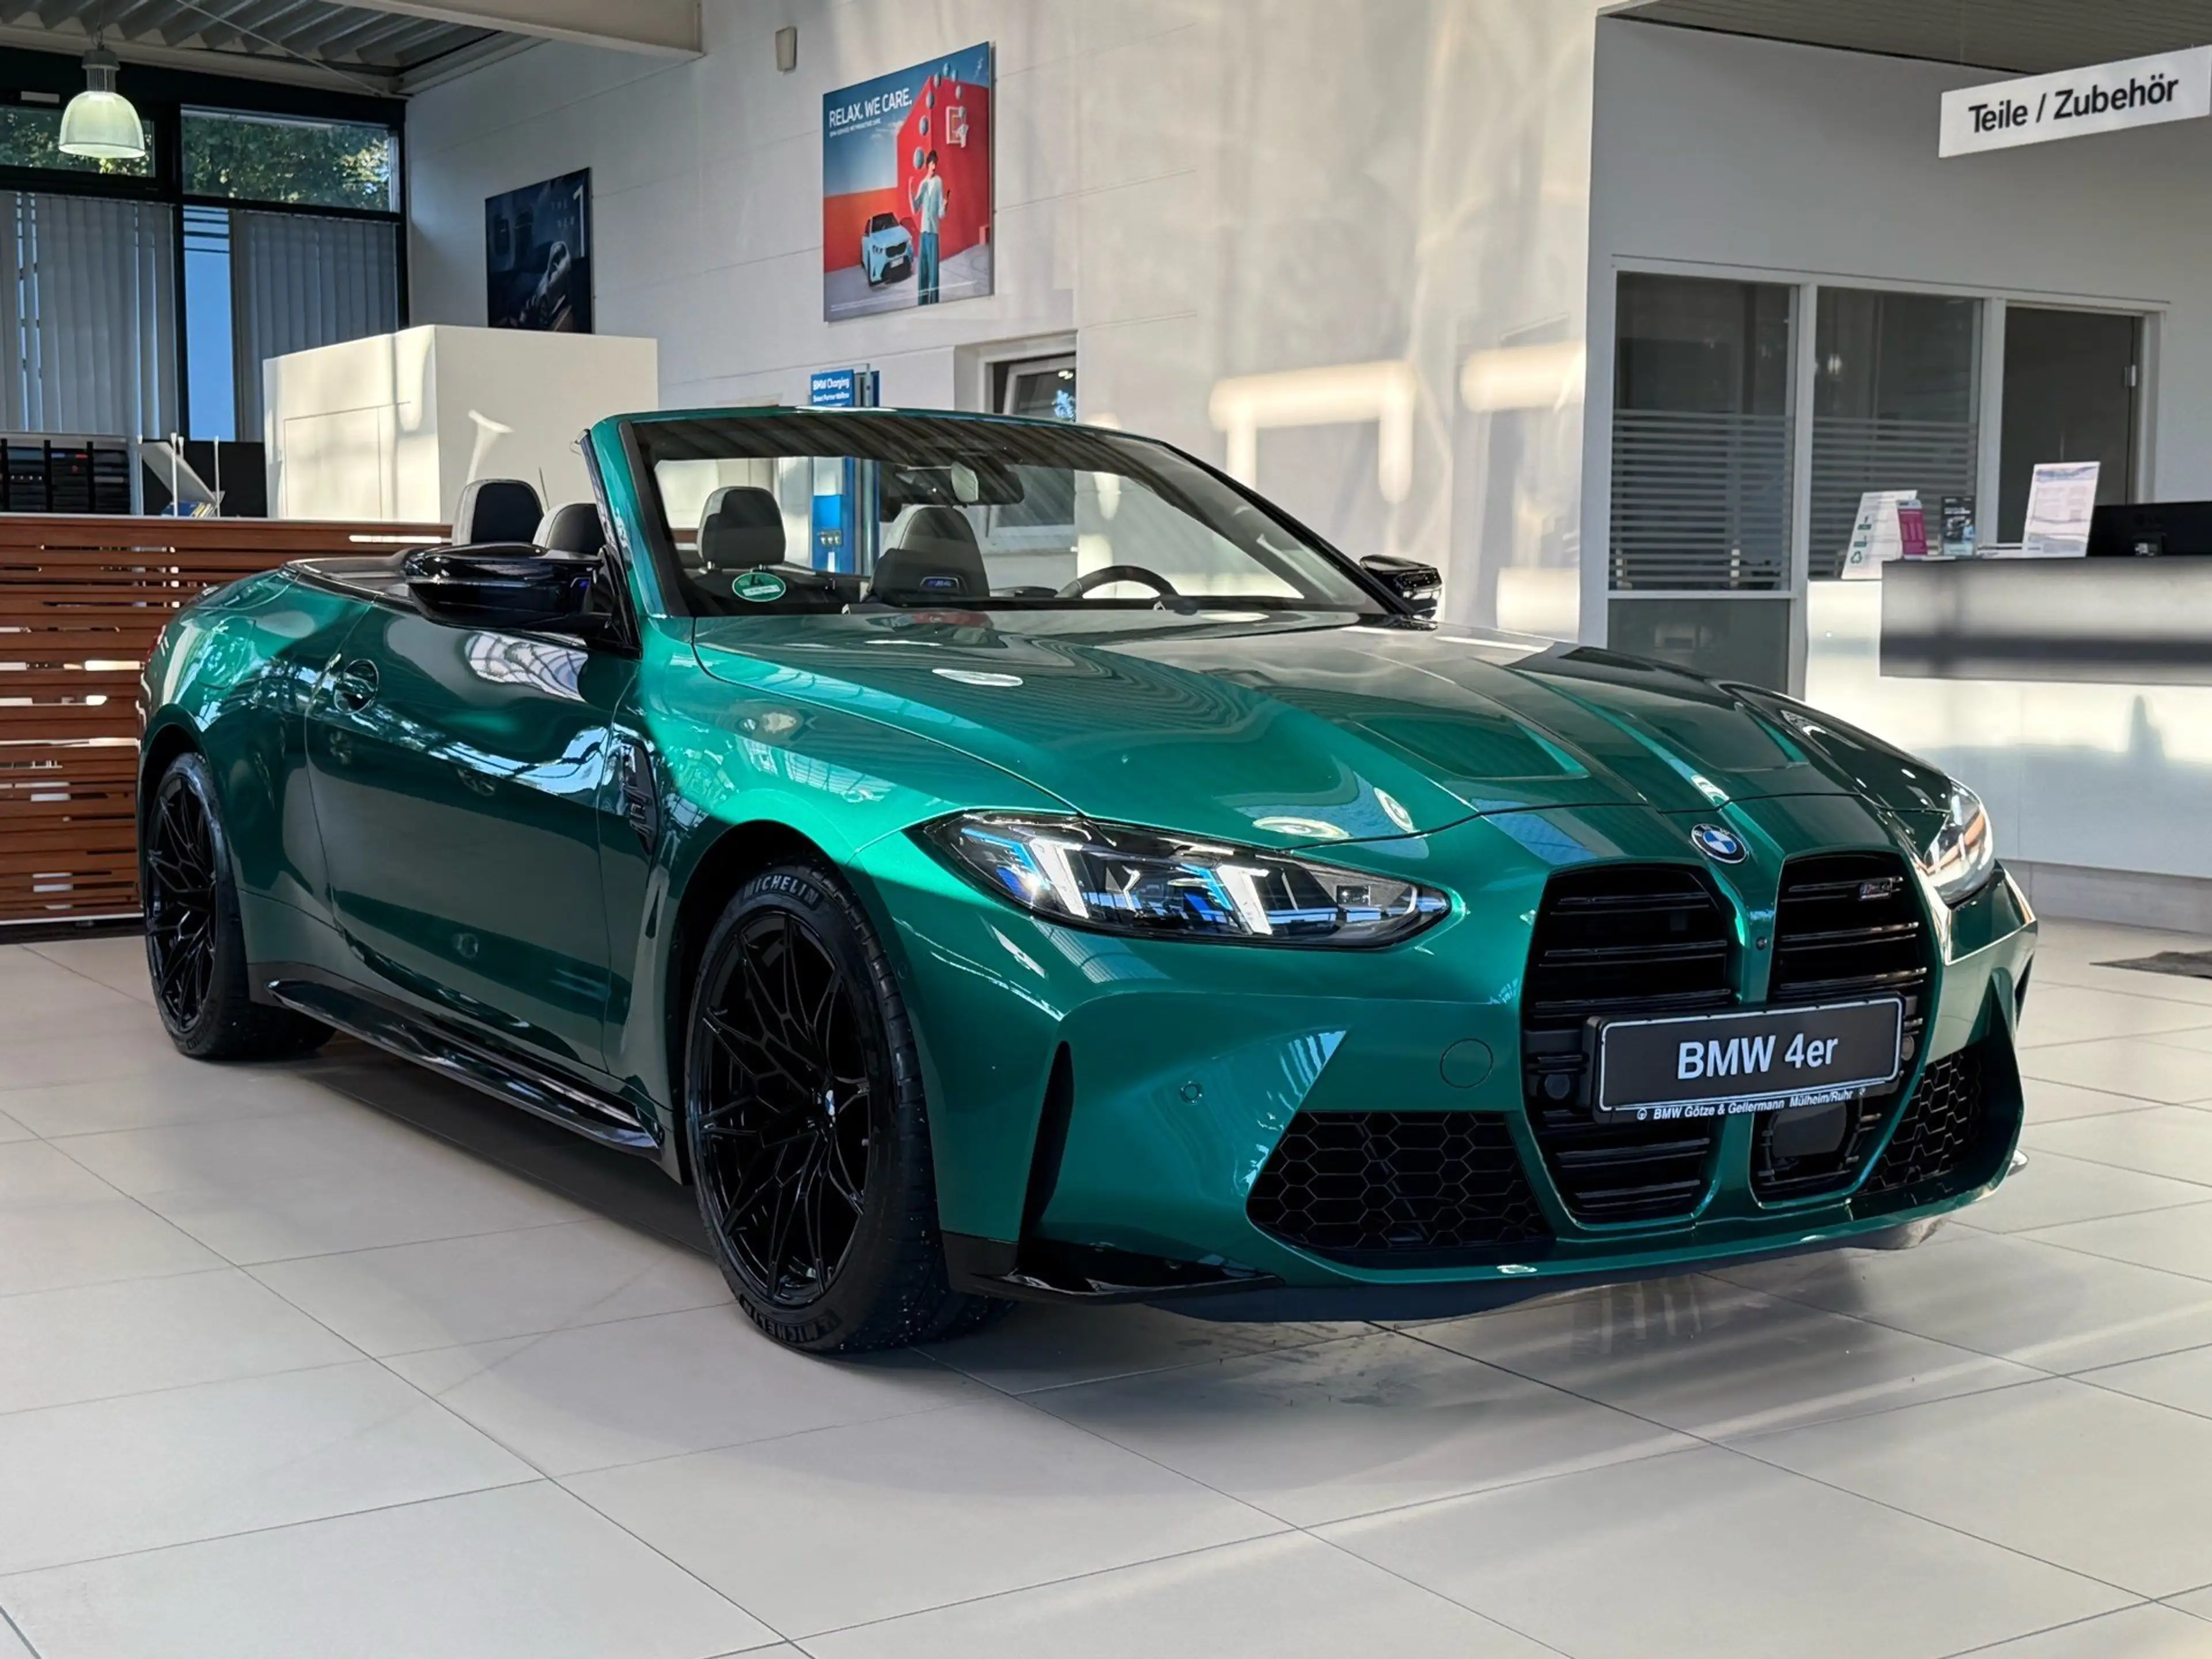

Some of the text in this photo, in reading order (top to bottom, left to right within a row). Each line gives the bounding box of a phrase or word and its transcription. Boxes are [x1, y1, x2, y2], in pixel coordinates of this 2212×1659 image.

[829, 103, 863, 128] RELAX.
[865, 96, 881, 118] WE
[882, 87, 912, 112] CARE.
[1968, 73, 2179, 133] Teile / Zubehör
[744, 875, 820, 906] MICHELIN
[1677, 1033, 1839, 1080] BMW 4er
[1653, 1090, 1854, 1120] BMW Götze & Gellermann Mülheim/Ruhr
